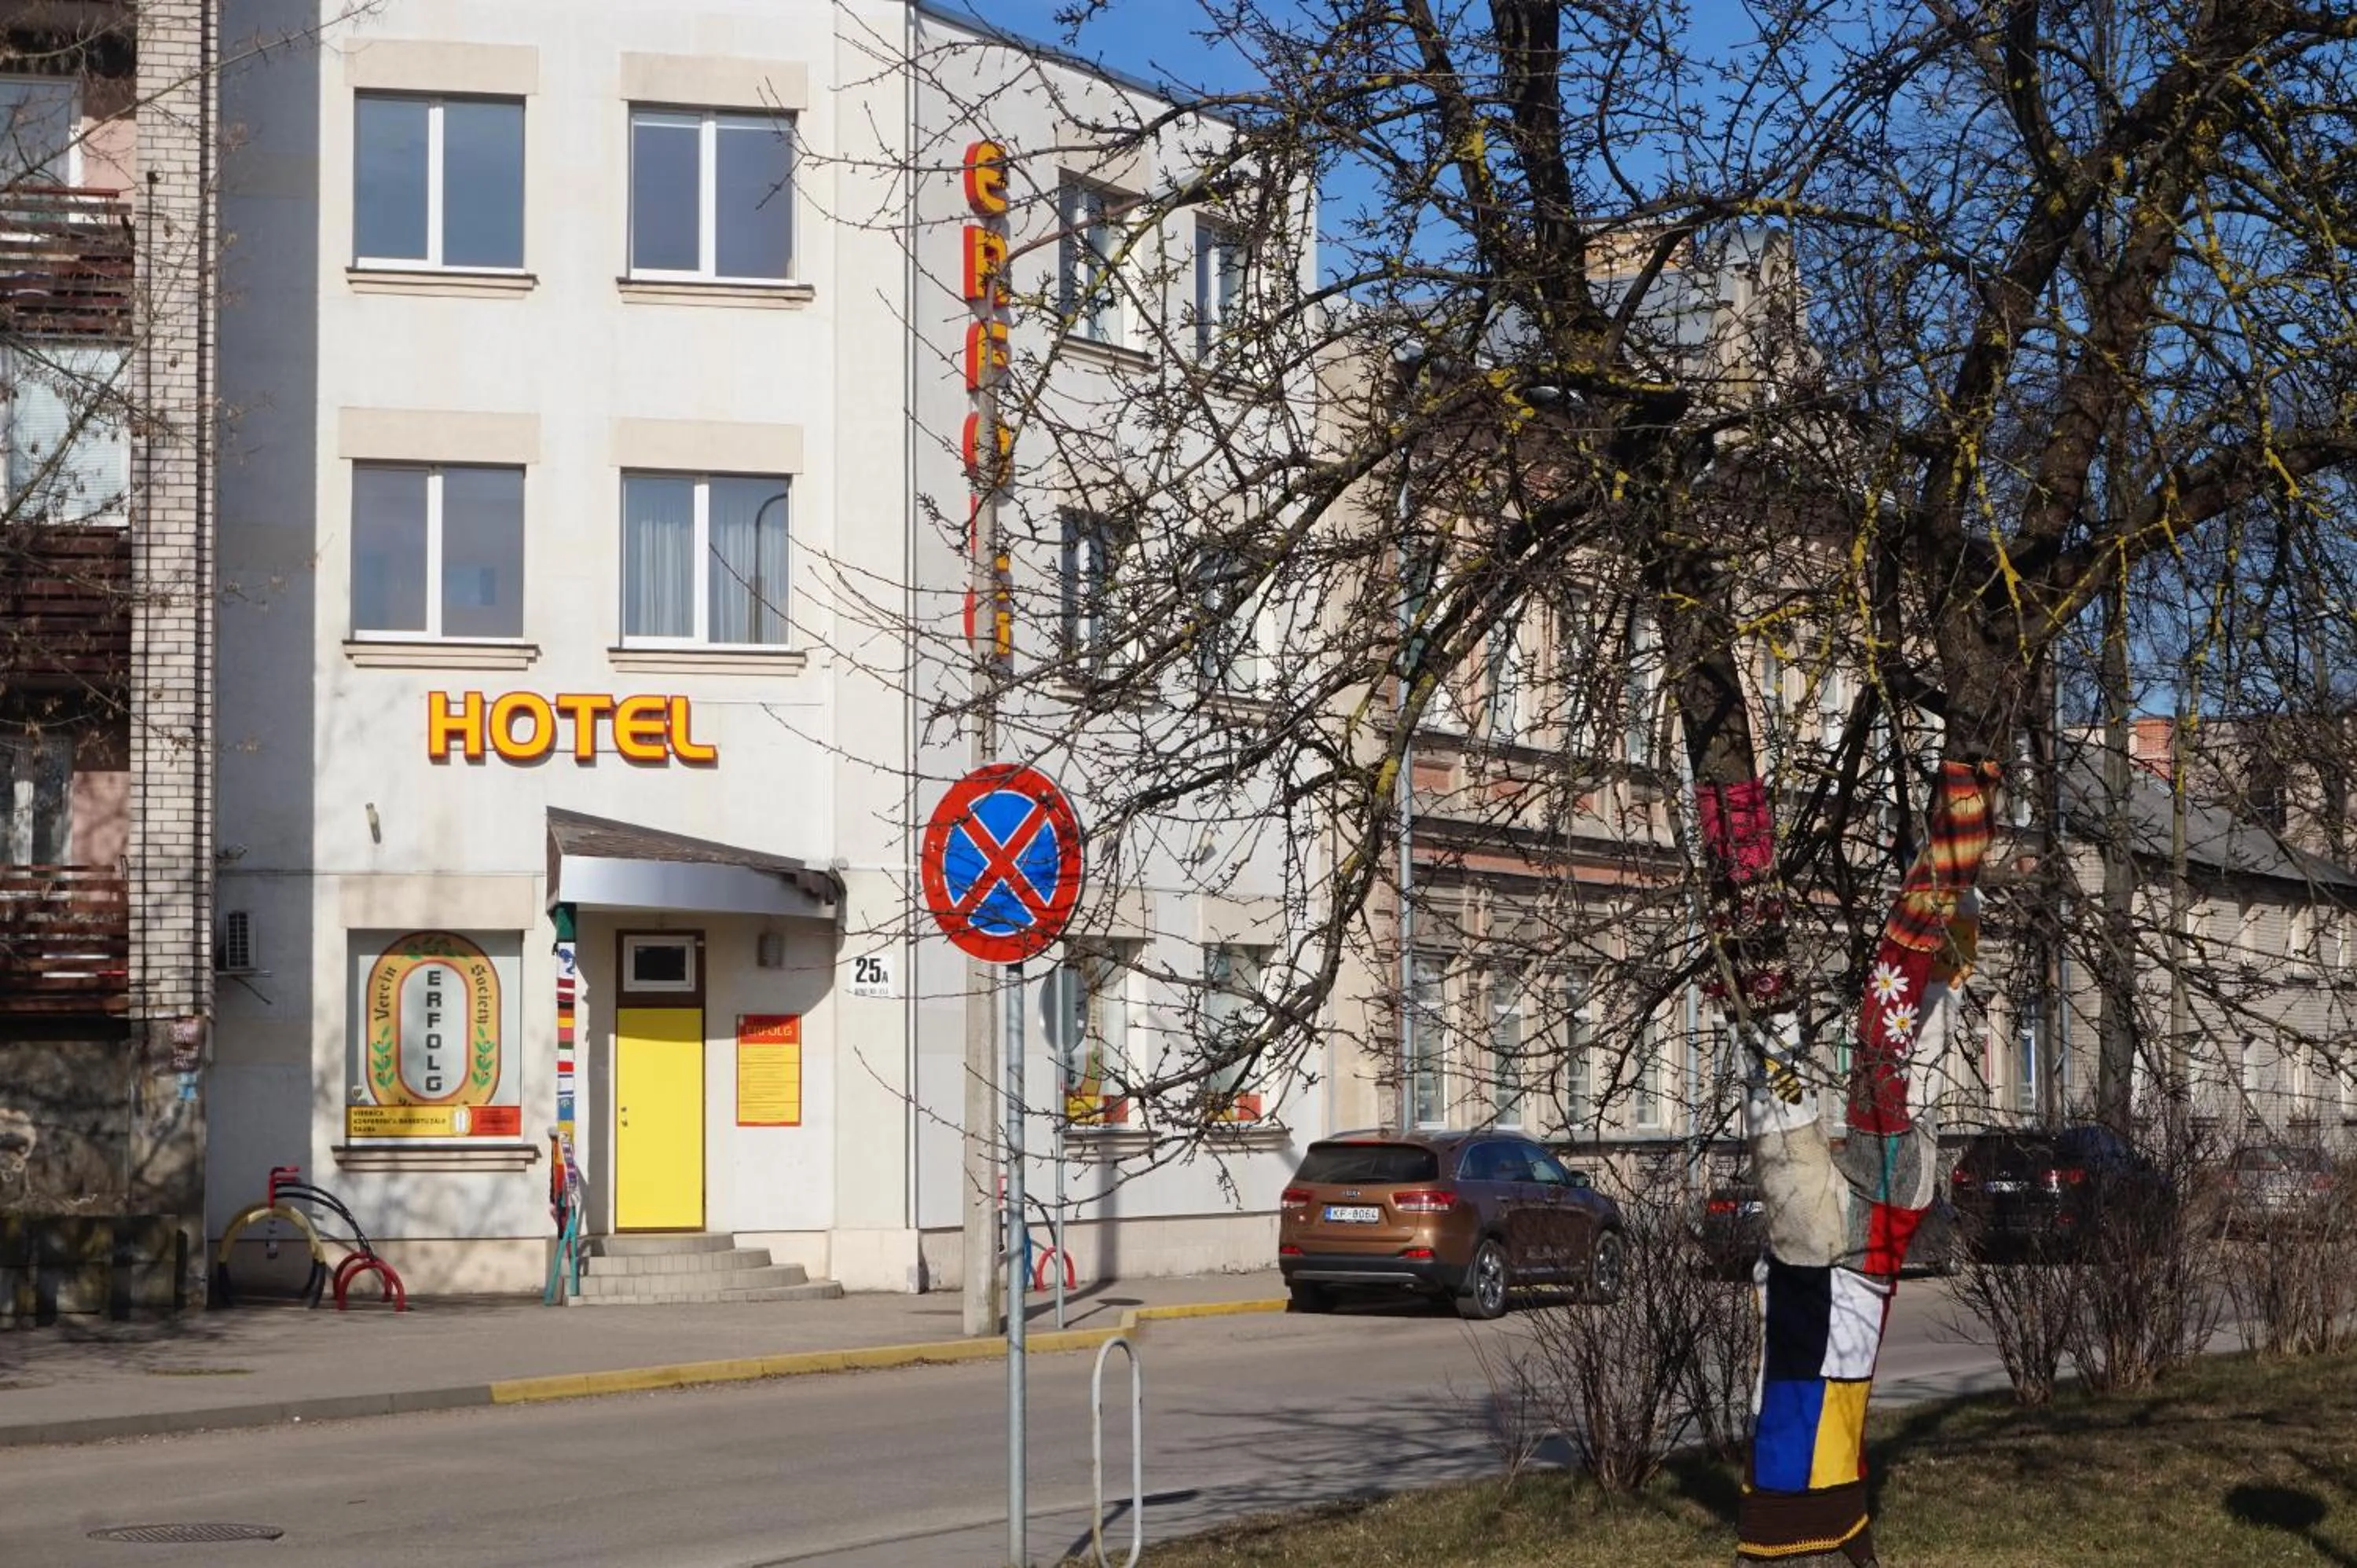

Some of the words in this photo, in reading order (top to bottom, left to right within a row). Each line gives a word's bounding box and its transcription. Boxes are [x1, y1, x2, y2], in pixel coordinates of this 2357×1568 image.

[428, 691, 717, 763] HOTEL
[375, 966, 397, 1021] Verein
[471, 964, 493, 1024] Society
[426, 970, 442, 1092] ERFOLG
